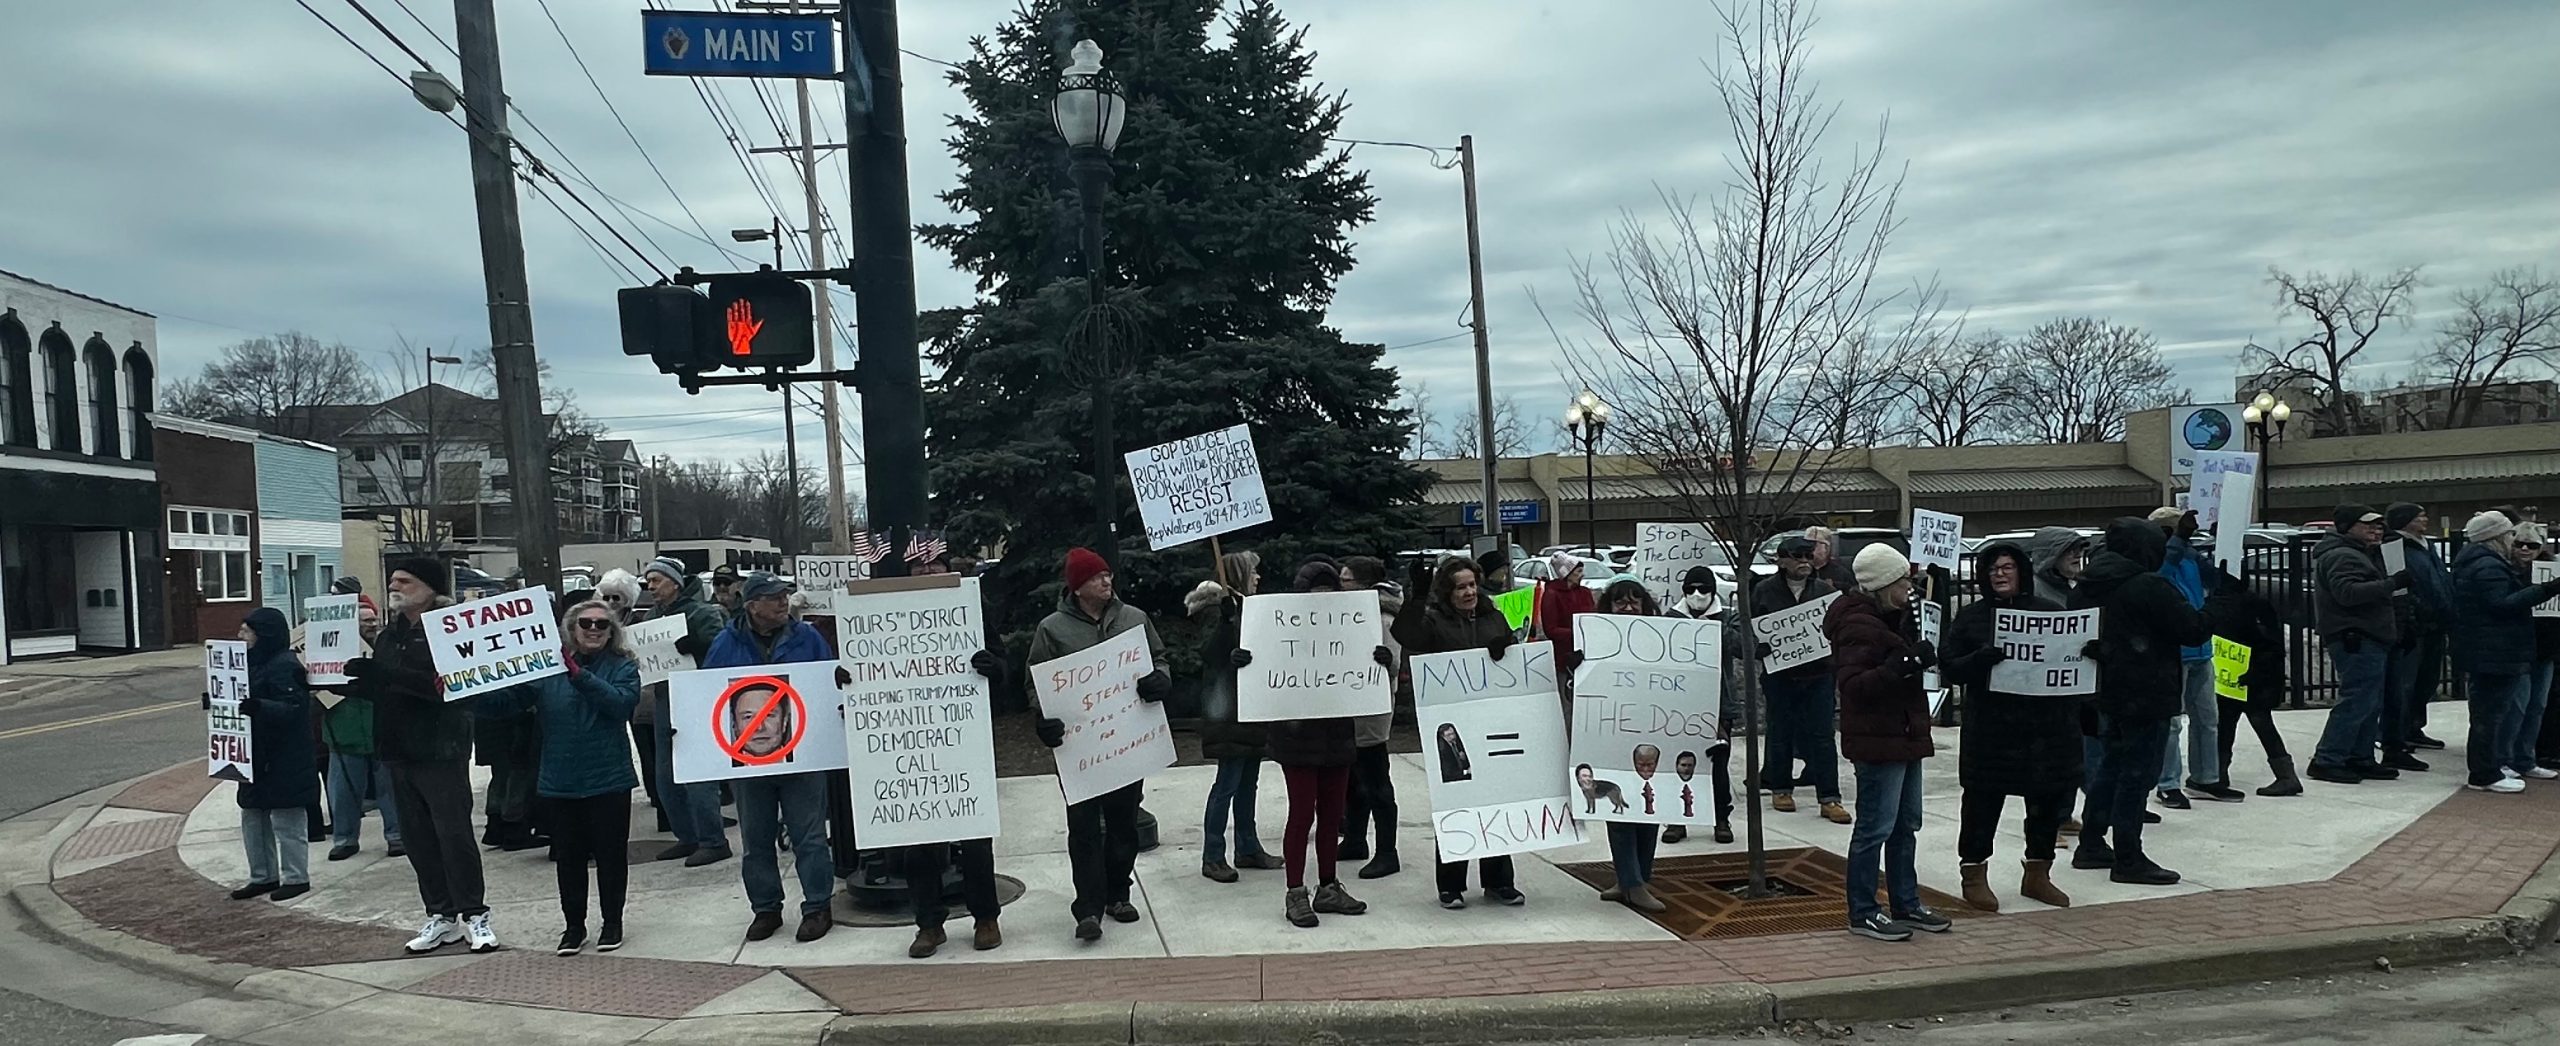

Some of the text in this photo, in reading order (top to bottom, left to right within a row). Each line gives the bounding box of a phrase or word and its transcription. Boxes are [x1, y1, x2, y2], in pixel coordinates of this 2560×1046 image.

[704, 27, 816, 62] MAIN ST
[1150, 429, 1231, 462] GOP BUDGET
[1134, 463, 1167, 485] RICH
[1207, 439, 1251, 466] RICHER
[1137, 477, 1174, 502] POOR
[1210, 457, 1258, 483] POORER
[1169, 482, 1233, 515] RESIST
[1932, 532, 1947, 544] NOT
[798, 560, 871, 578] PROTEC
[442, 597, 534, 634] STAND
[843, 614, 884, 635] YOUR
[910, 605, 968, 631] DISTRICT
[1274, 609, 1366, 627] Retire
[1758, 599, 1829, 635] Corporat
[1998, 614, 2091, 635] SUPPORT
[321, 630, 340, 648] NOT
[455, 623, 547, 659] WITH
[845, 630, 978, 659] CONGRESSMAN
[1579, 614, 1720, 669] DOGE
[1769, 626, 1810, 648] Greed
[1052, 646, 1141, 693] $TOP THE
[1771, 643, 1815, 666] People
[443, 649, 559, 692] UKRAINE
[855, 661, 887, 682] TIM
[1421, 647, 1552, 700] MUSK
[1612, 671, 1686, 692] IS FOR
[2046, 668, 2079, 687] DEI
[847, 684, 979, 708] IS HELPING TRUMP/MUSK
[855, 701, 975, 731] DISMANTLE YOUR
[1090, 713, 1114, 727] TAX
[1575, 694, 1718, 740] THE DOGS
[211, 734, 250, 764] STEAL
[867, 727, 963, 753] DEMOCRACY
[896, 753, 940, 774] CALL
[871, 803, 904, 825] AND
[908, 800, 942, 822] ASK
[1439, 802, 1580, 855] SKUM
